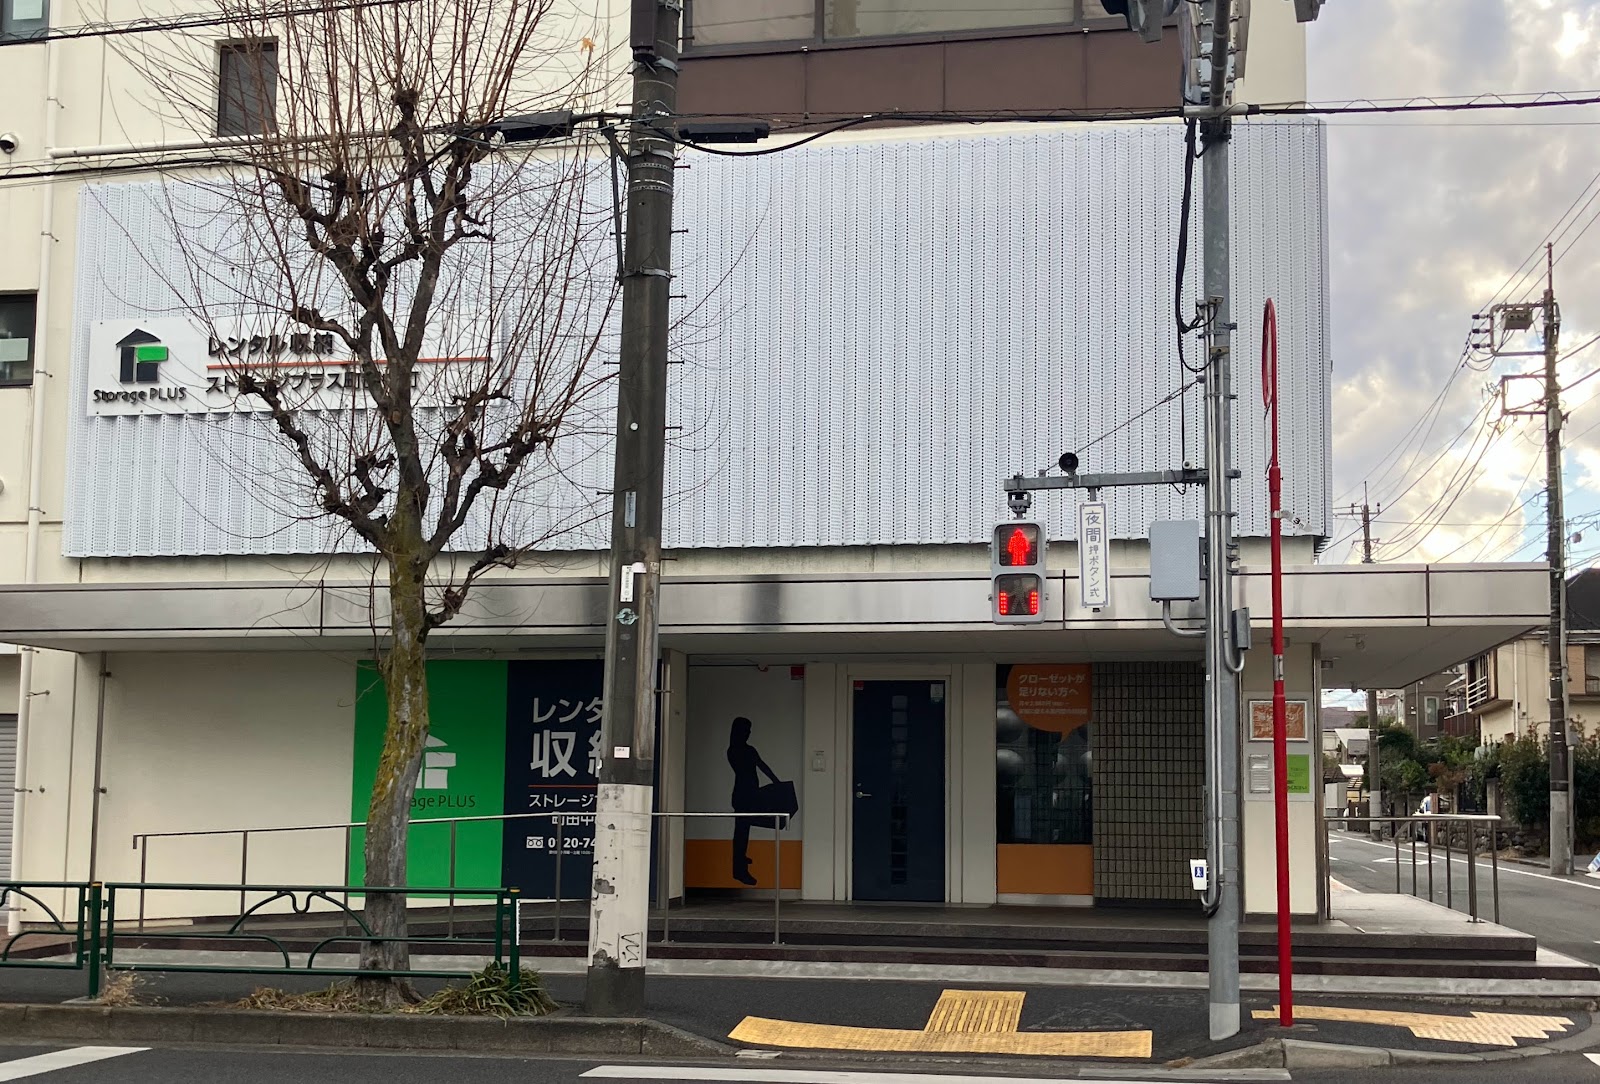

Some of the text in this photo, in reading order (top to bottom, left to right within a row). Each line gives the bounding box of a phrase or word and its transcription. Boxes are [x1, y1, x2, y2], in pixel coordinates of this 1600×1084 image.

[93, 386, 187, 406] Storage PLUS
[1085, 510, 1101, 597] 夜間押ボタン式
[1018, 673, 1085, 684] クローゼットが
[1018, 686, 1079, 697] 足りない方へ
[439, 795, 476, 807] PLUS
[529, 793, 598, 808] ストレージ
[548, 837, 596, 848] 020-74
